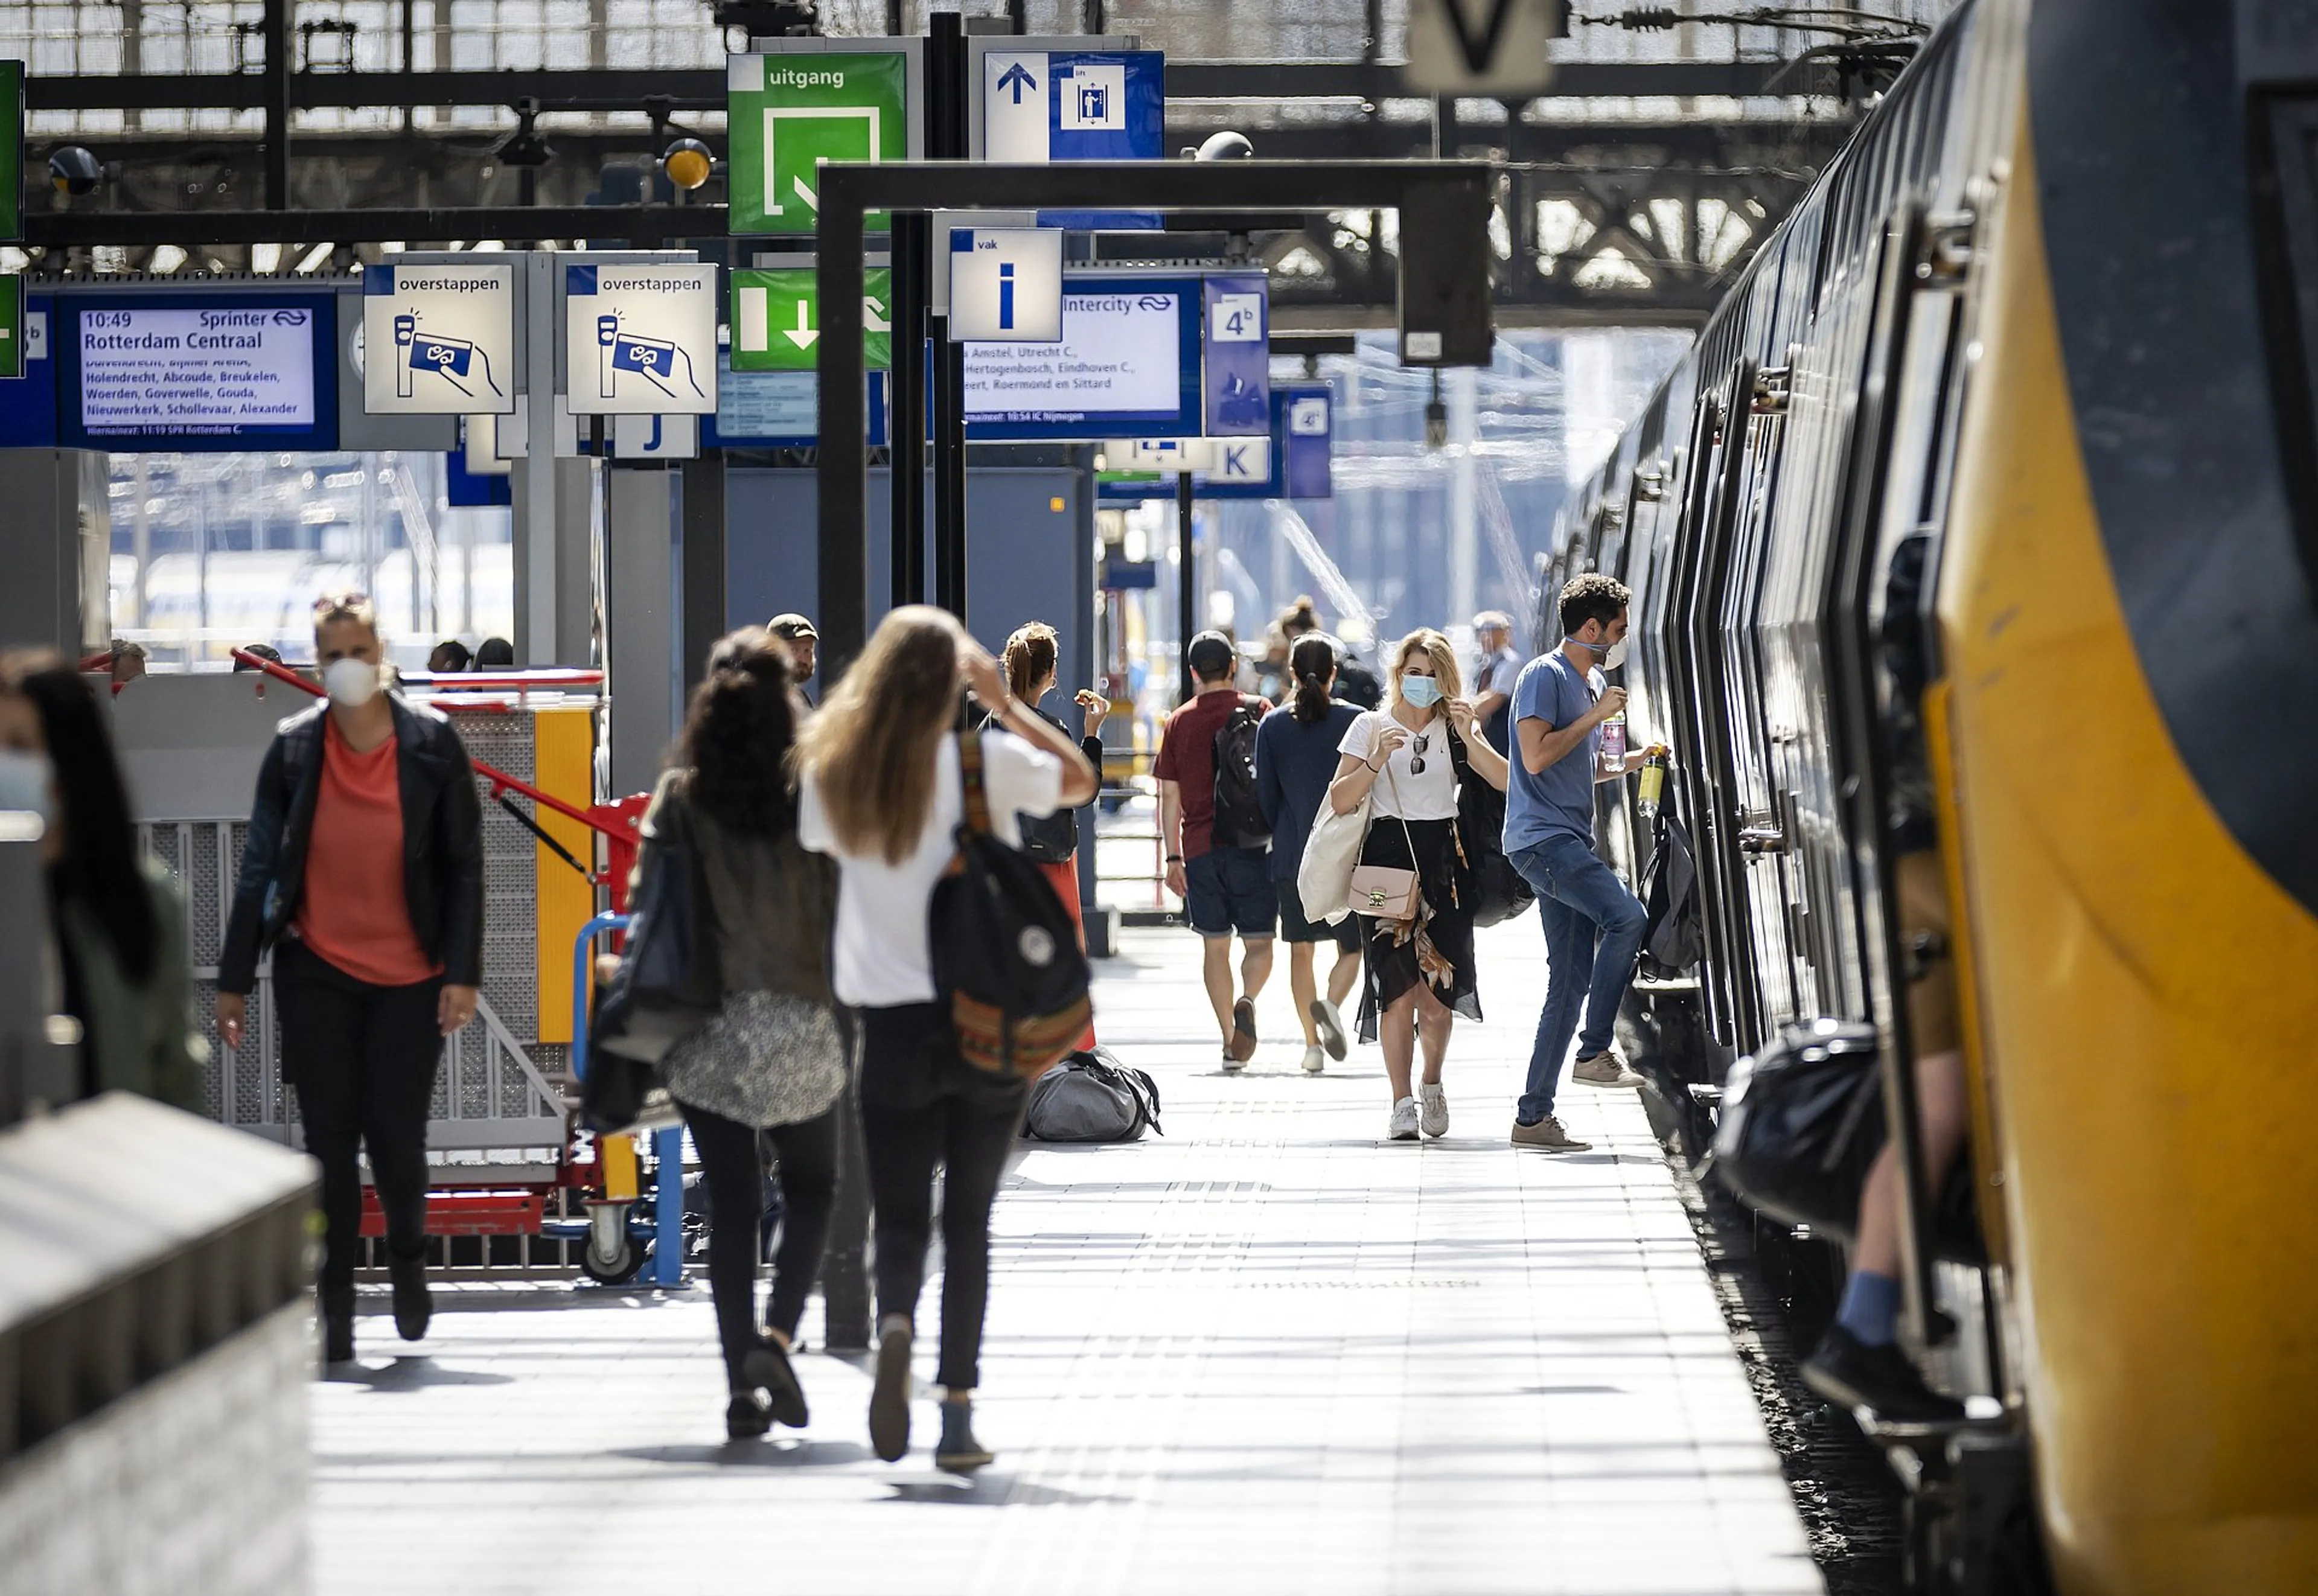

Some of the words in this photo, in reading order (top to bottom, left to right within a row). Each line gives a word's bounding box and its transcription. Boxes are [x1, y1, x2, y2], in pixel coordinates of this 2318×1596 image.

[770, 68, 844, 89] uitgang
[977, 240, 998, 249] vak
[400, 278, 499, 292] overstappen
[602, 278, 701, 292] overstappen
[1063, 296, 1131, 314] Intercity
[86, 311, 132, 328] 10:49
[200, 311, 267, 331] Sprinter
[85, 333, 180, 349] Rotterdam
[186, 331, 261, 349] Centraal
[972, 348, 1013, 358] Amstel,
[1018, 347, 1060, 357] Utrecht
[965, 363, 1053, 376] Hertogenbosch,
[1058, 363, 1117, 372] Eindhoven
[86, 372, 159, 384] Holendrecht,
[163, 372, 216, 383] Abcoude,
[220, 370, 281, 383] Breukelen,
[964, 381, 988, 391] eert,
[994, 380, 1051, 389] Roermond
[1074, 377, 1111, 389] Sittard
[86, 388, 141, 401] Woerden,
[145, 388, 213, 400] Goverwelle,
[217, 387, 258, 400] Gouda,
[86, 403, 163, 417] Nieuwerkerk,
[167, 403, 236, 415] Schollevaar,
[240, 403, 298, 414] Alexander
[1225, 445, 1248, 476] K
